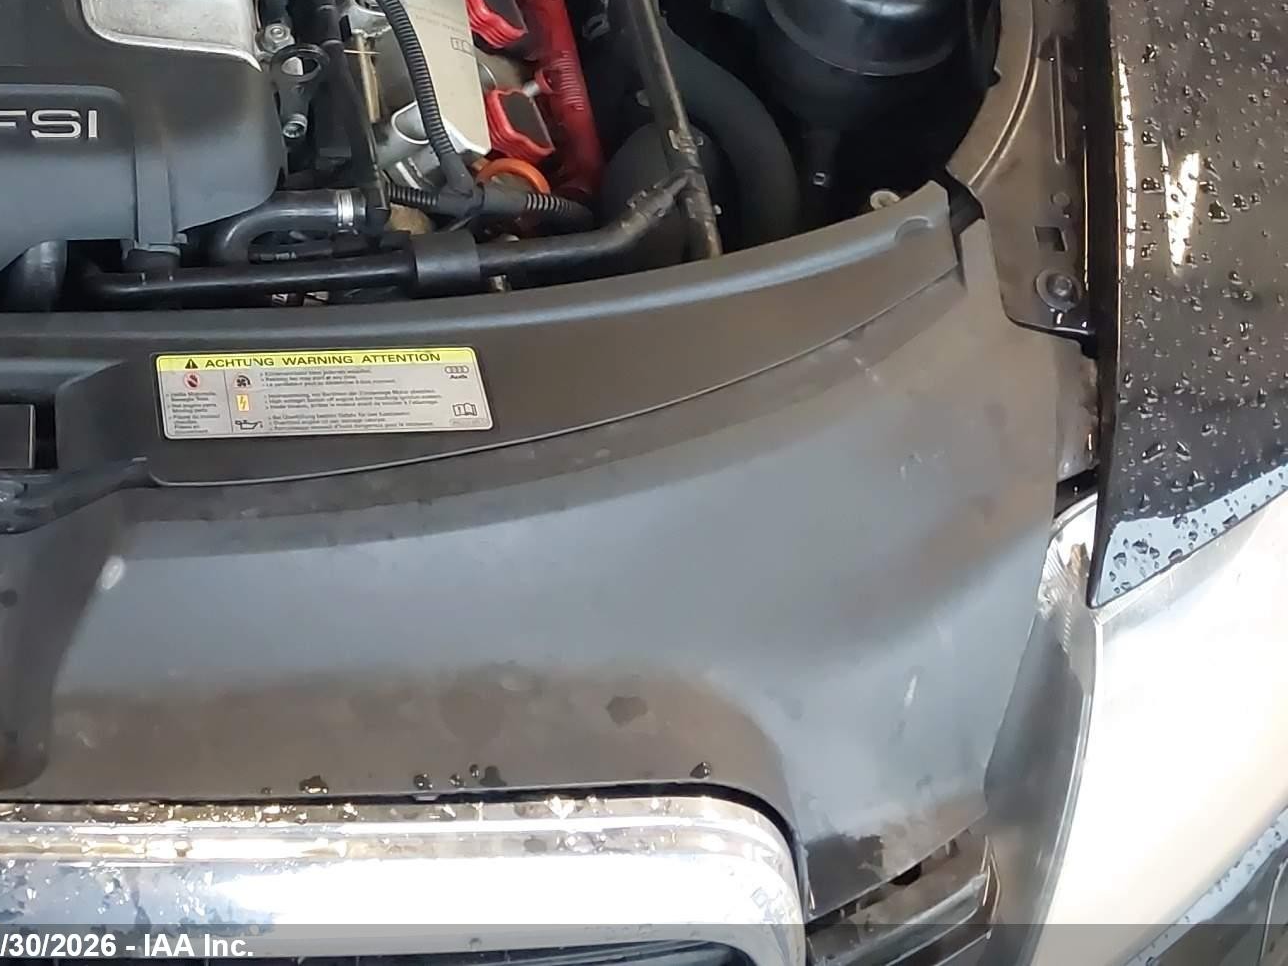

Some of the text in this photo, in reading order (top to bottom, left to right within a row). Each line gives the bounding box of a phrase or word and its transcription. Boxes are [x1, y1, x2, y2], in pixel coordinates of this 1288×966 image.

[205, 353, 441, 368] ACHTUNG WARNING ATTENTION
